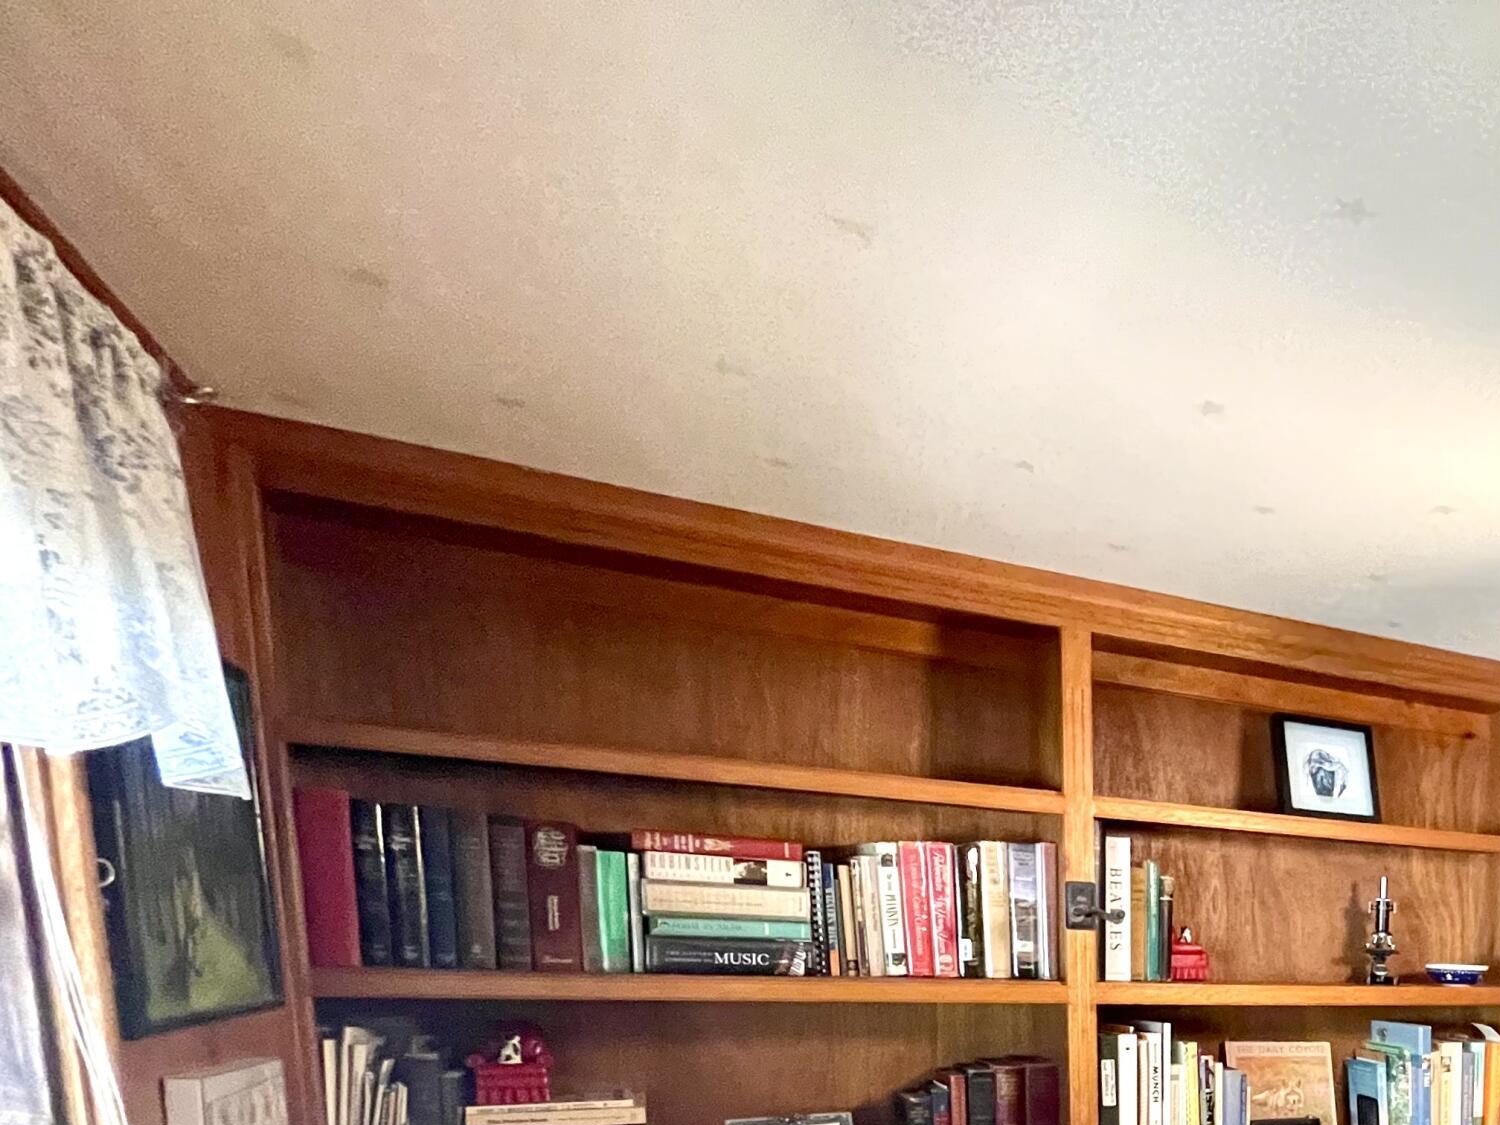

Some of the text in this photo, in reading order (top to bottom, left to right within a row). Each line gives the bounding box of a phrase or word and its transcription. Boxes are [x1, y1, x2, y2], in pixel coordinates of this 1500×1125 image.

[1109, 868, 1123, 952] BEAES
[714, 952, 770, 966] MUSIC
[1152, 1066, 1160, 1103] MUNCH
